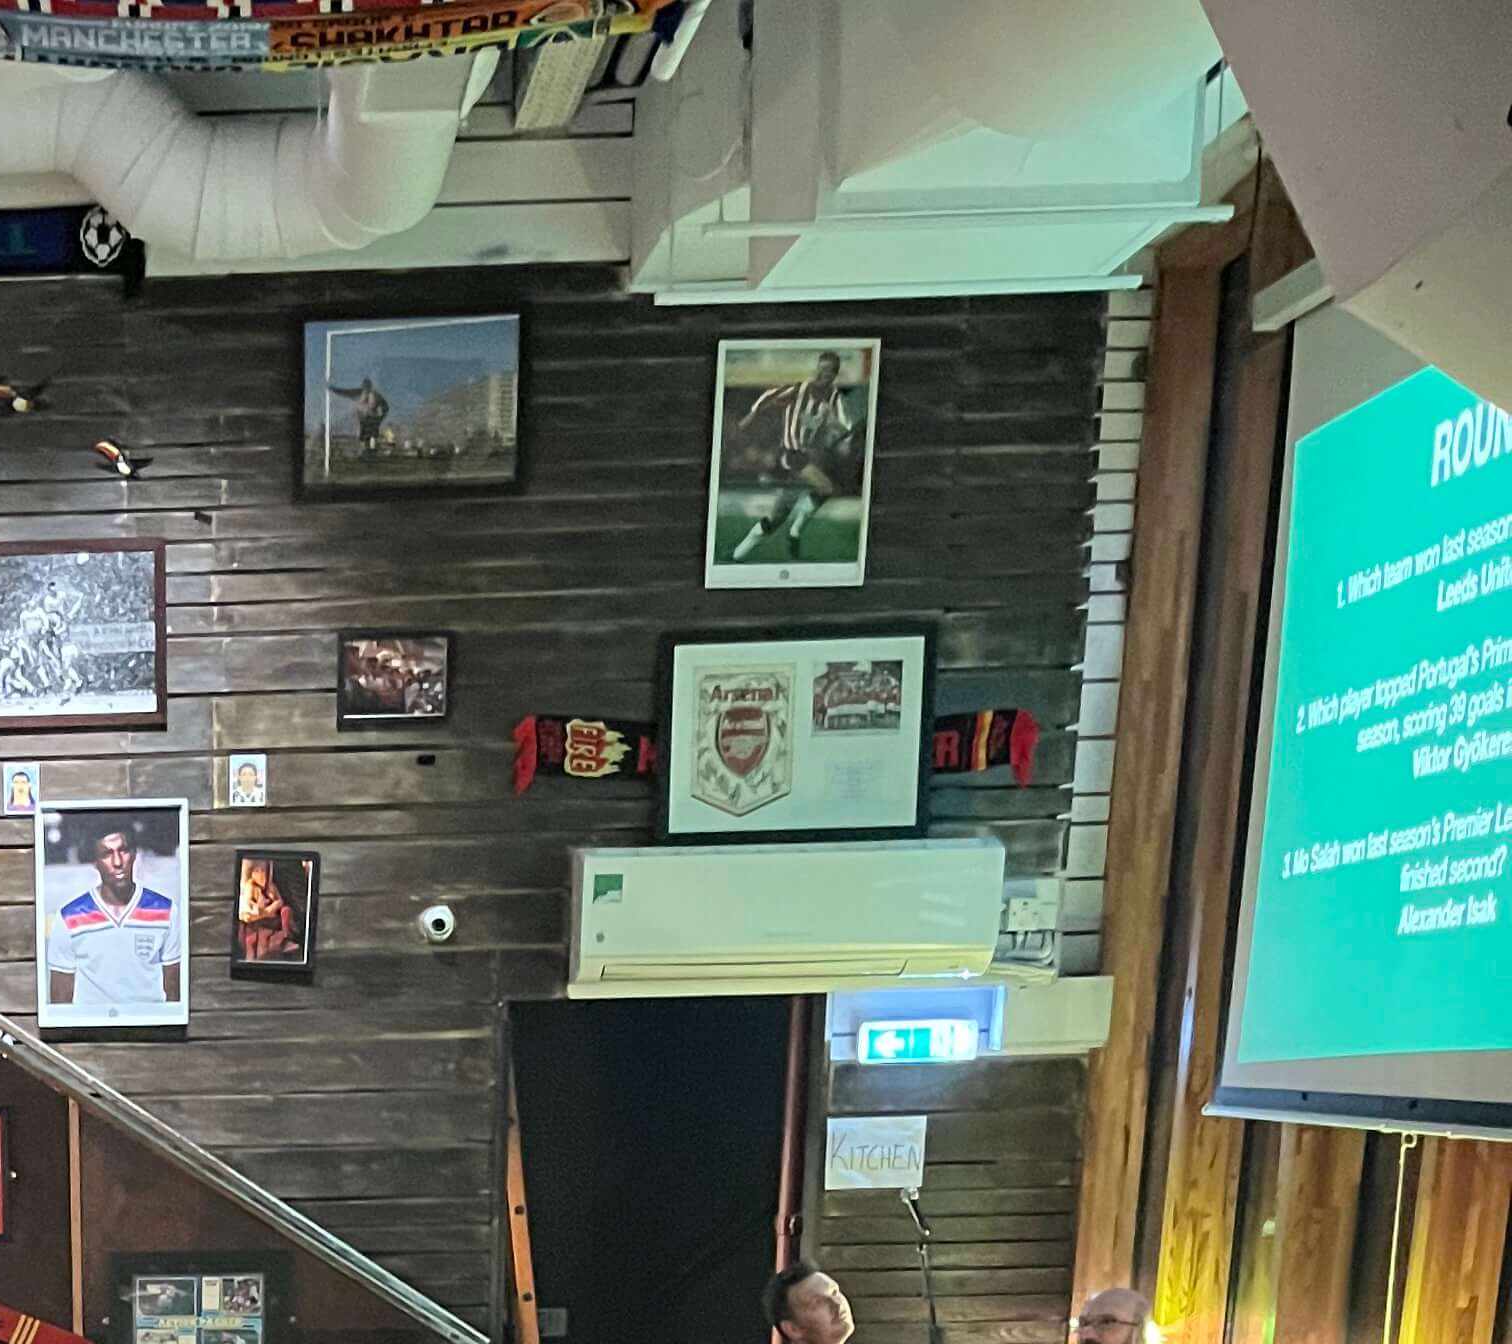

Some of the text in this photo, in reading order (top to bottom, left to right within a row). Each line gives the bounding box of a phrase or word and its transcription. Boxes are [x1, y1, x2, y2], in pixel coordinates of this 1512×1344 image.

[21, 24, 253, 52] MANCHESTER
[290, 10, 517, 48] SHAKHTAR
[1348, 565, 1382, 604] Which
[1383, 555, 1413, 590] team
[1414, 544, 1440, 577] won
[1442, 529, 1465, 565] last
[1437, 568, 1479, 613] Leeds
[1308, 693, 1339, 729] Which
[1338, 684, 1374, 725] player
[1375, 663, 1417, 709] topped
[1418, 644, 1479, 689] Portugal's
[1356, 718, 1401, 752] season,
[1403, 701, 1448, 739] scoring
[1449, 690, 1466, 725] 39
[1467, 682, 1504, 728] goals
[1413, 744, 1452, 779] Viktor
[1293, 847, 1309, 876] Mo
[1310, 840, 1340, 872] Salah
[1342, 838, 1365, 865] won
[1366, 829, 1389, 860] last
[1389, 815, 1440, 855] season's
[1441, 806, 1494, 843] Premier
[1400, 845, 1507, 892] finished second?
[1397, 890, 1497, 935] Alexander Isak
[831, 1127, 921, 1172] KITCHEN
